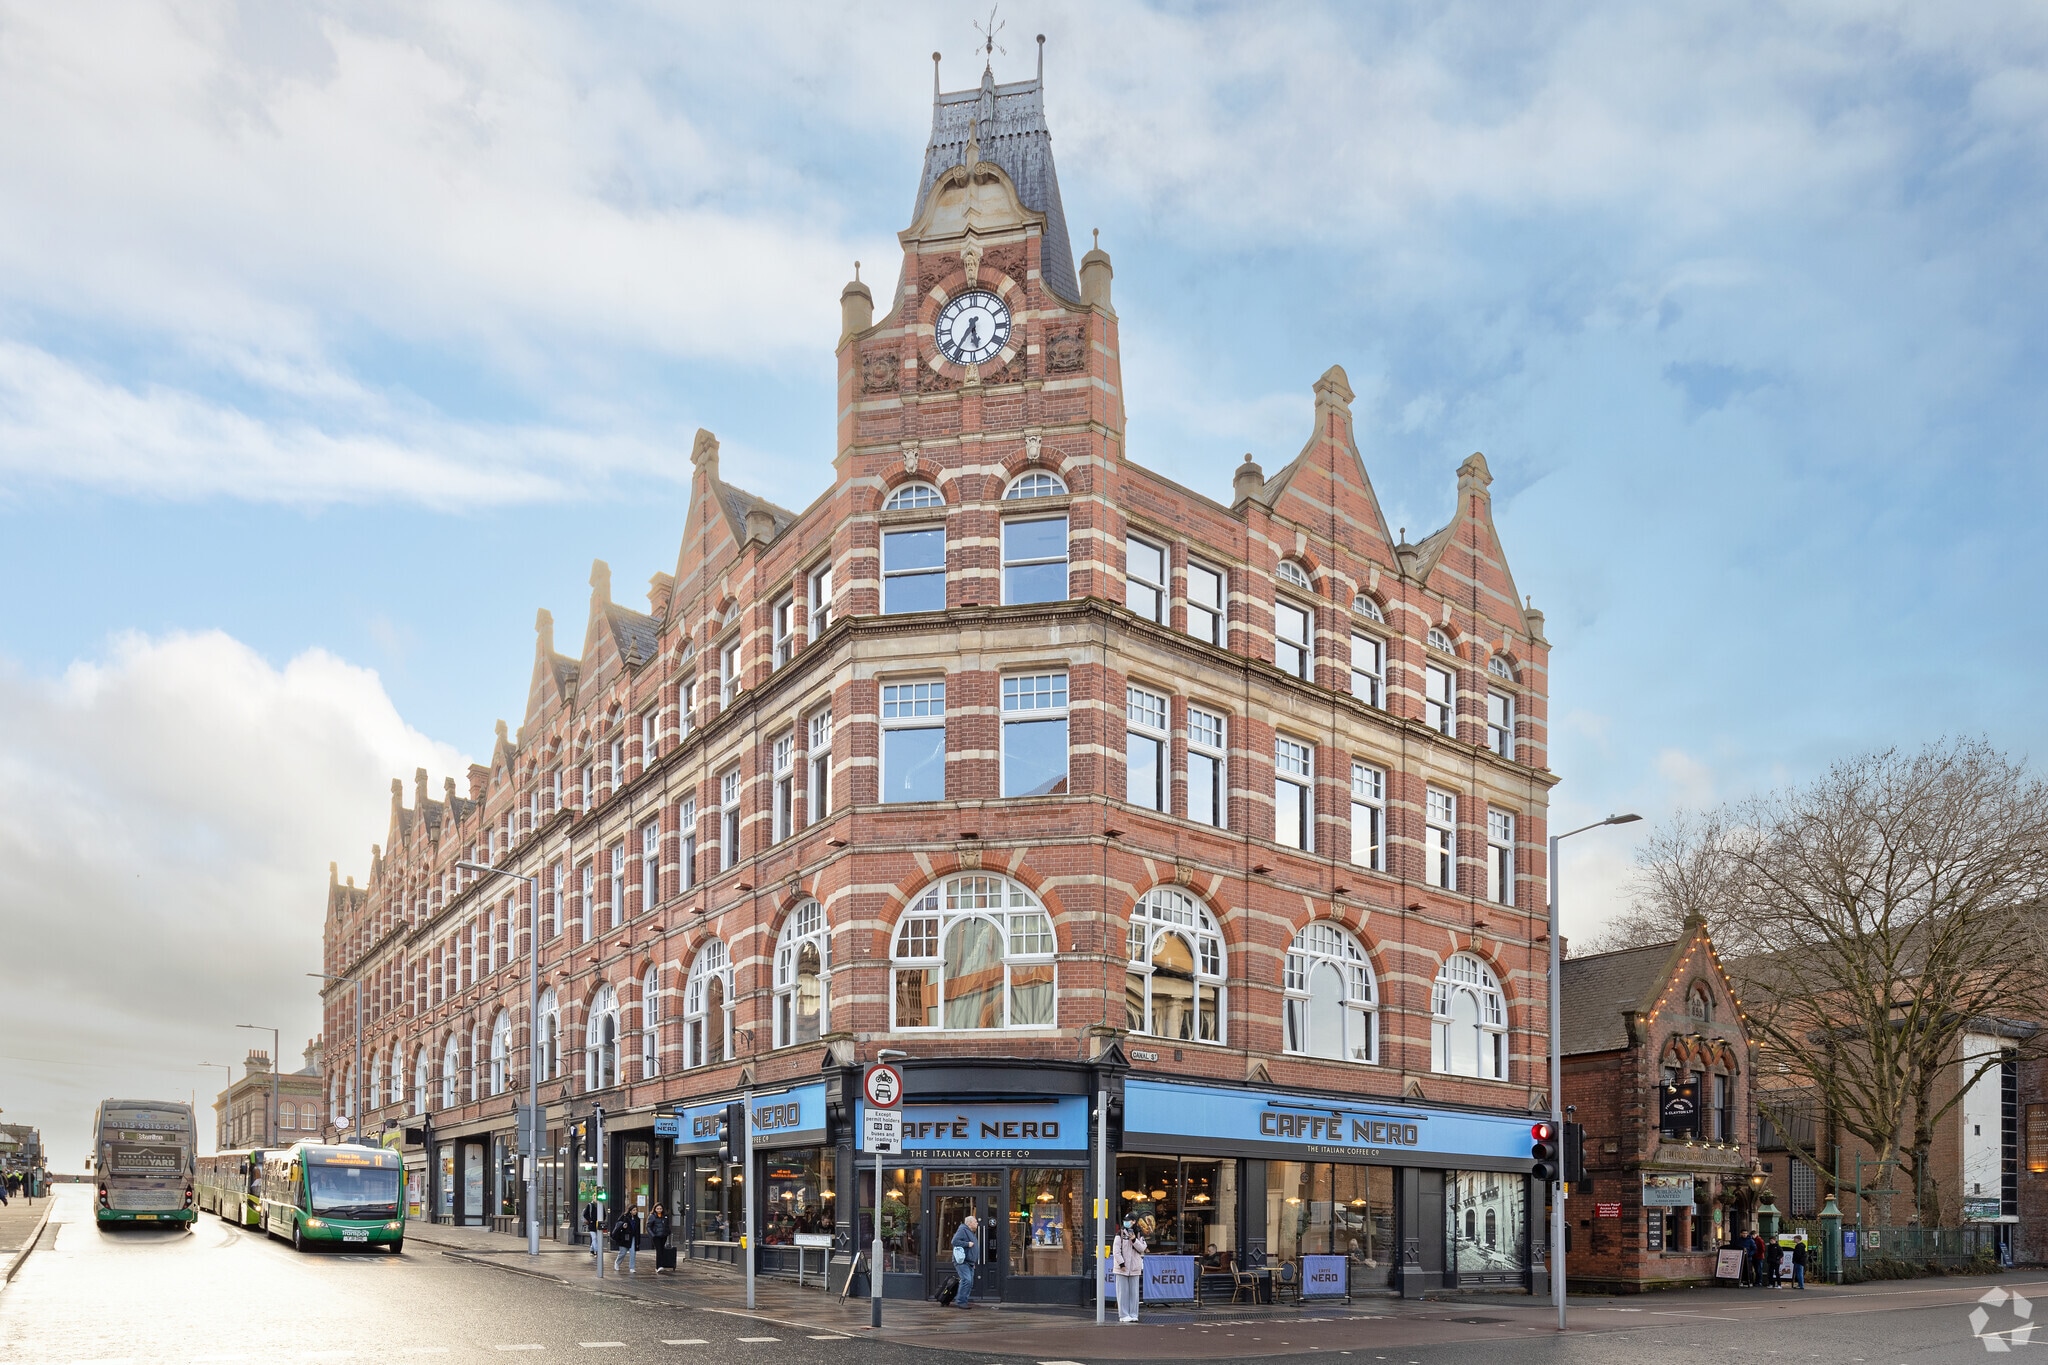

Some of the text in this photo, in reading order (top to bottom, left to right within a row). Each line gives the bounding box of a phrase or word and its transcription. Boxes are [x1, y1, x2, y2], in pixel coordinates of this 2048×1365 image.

[901, 1115, 1060, 1139] AFFÈ NERO
[1260, 1110, 1418, 1146] CAFFÈ NERO
[375, 1155, 382, 1166] 11
[1152, 1275, 1184, 1284] NERO
[1311, 1274, 1338, 1282] NERO
